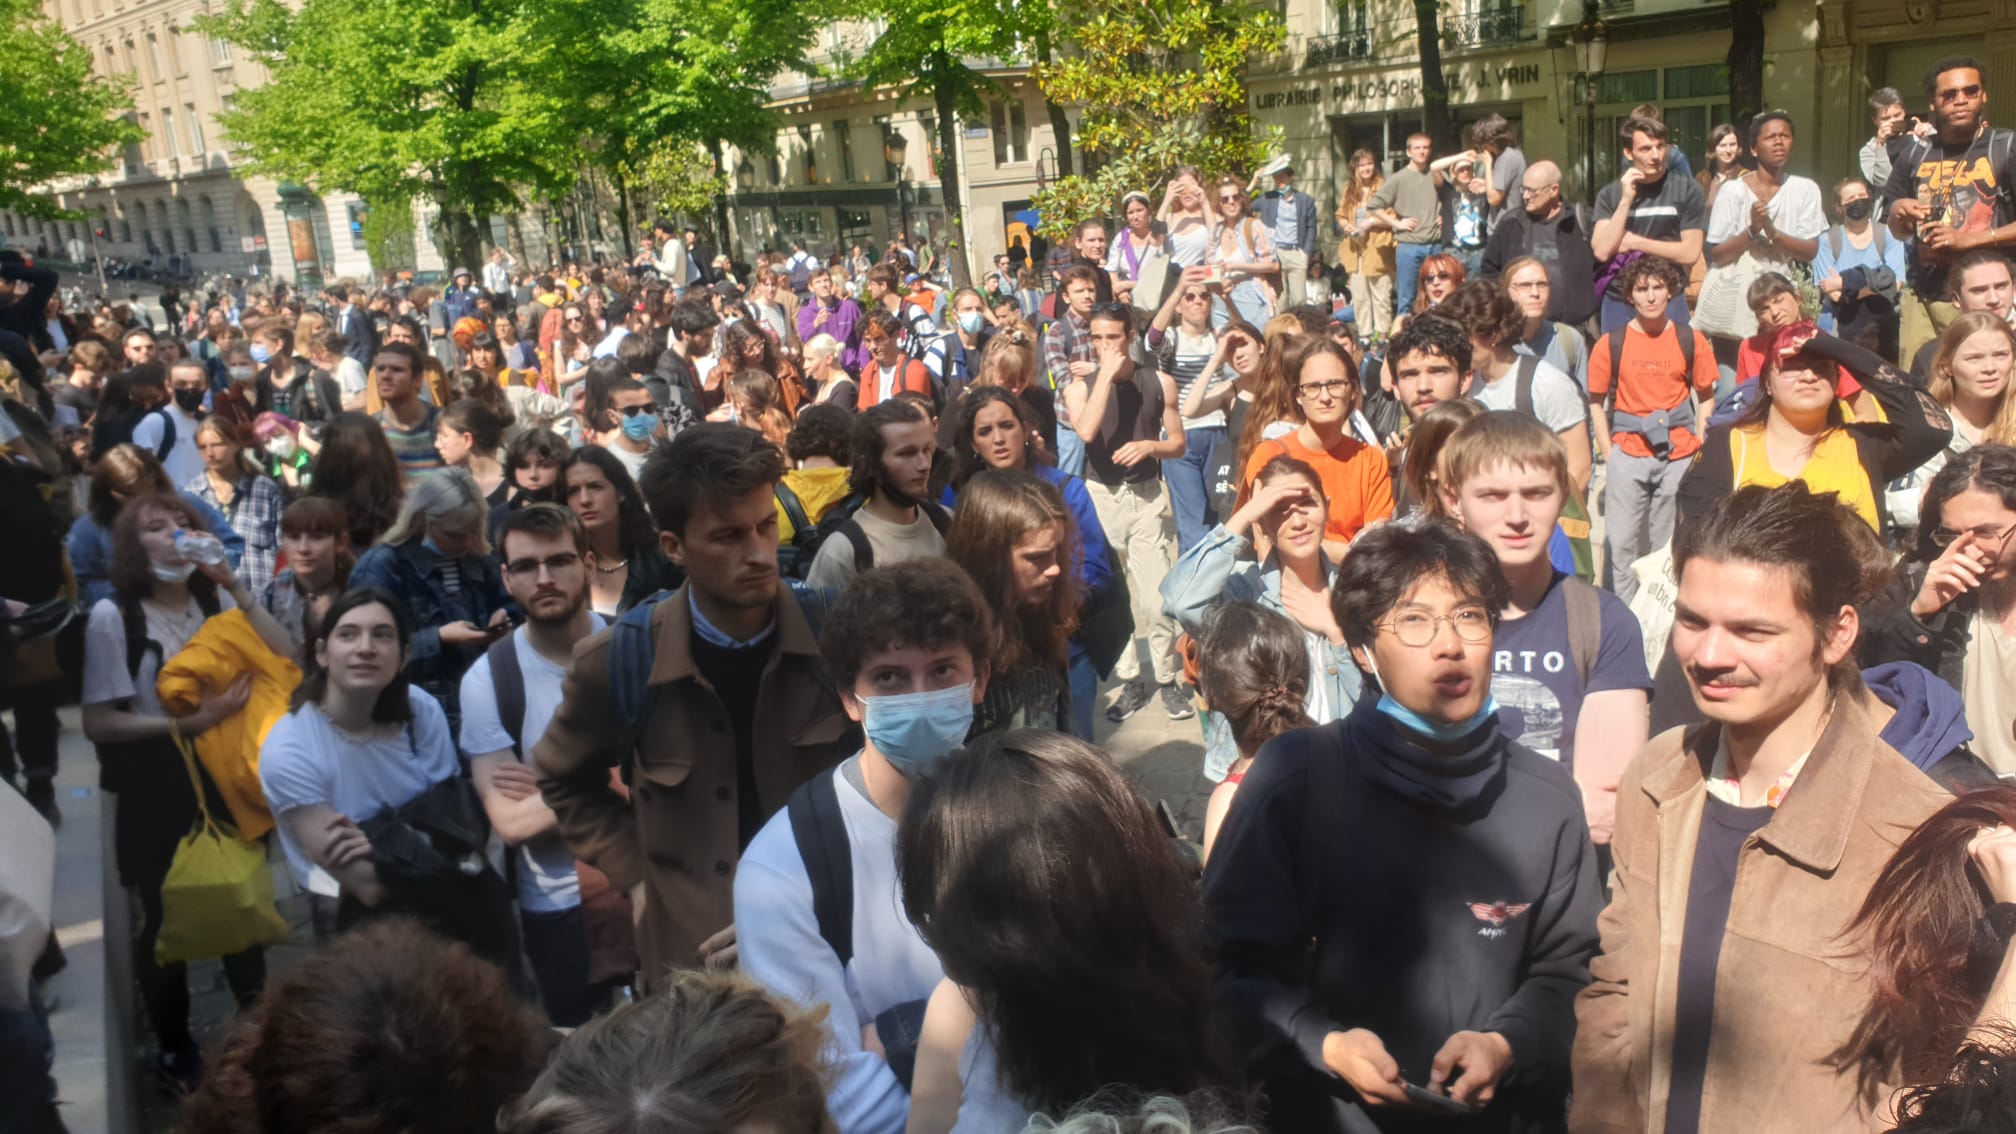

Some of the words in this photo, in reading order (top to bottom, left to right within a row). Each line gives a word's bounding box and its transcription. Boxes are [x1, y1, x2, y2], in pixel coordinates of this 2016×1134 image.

[1256, 87, 1321, 110] LIBRAIRIE
[1333, 72, 1462, 102] PHILOSOPHE
[1477, 69, 1491, 89] J.
[1495, 63, 1539, 86] VRIN
[1217, 464, 1231, 476] AT
